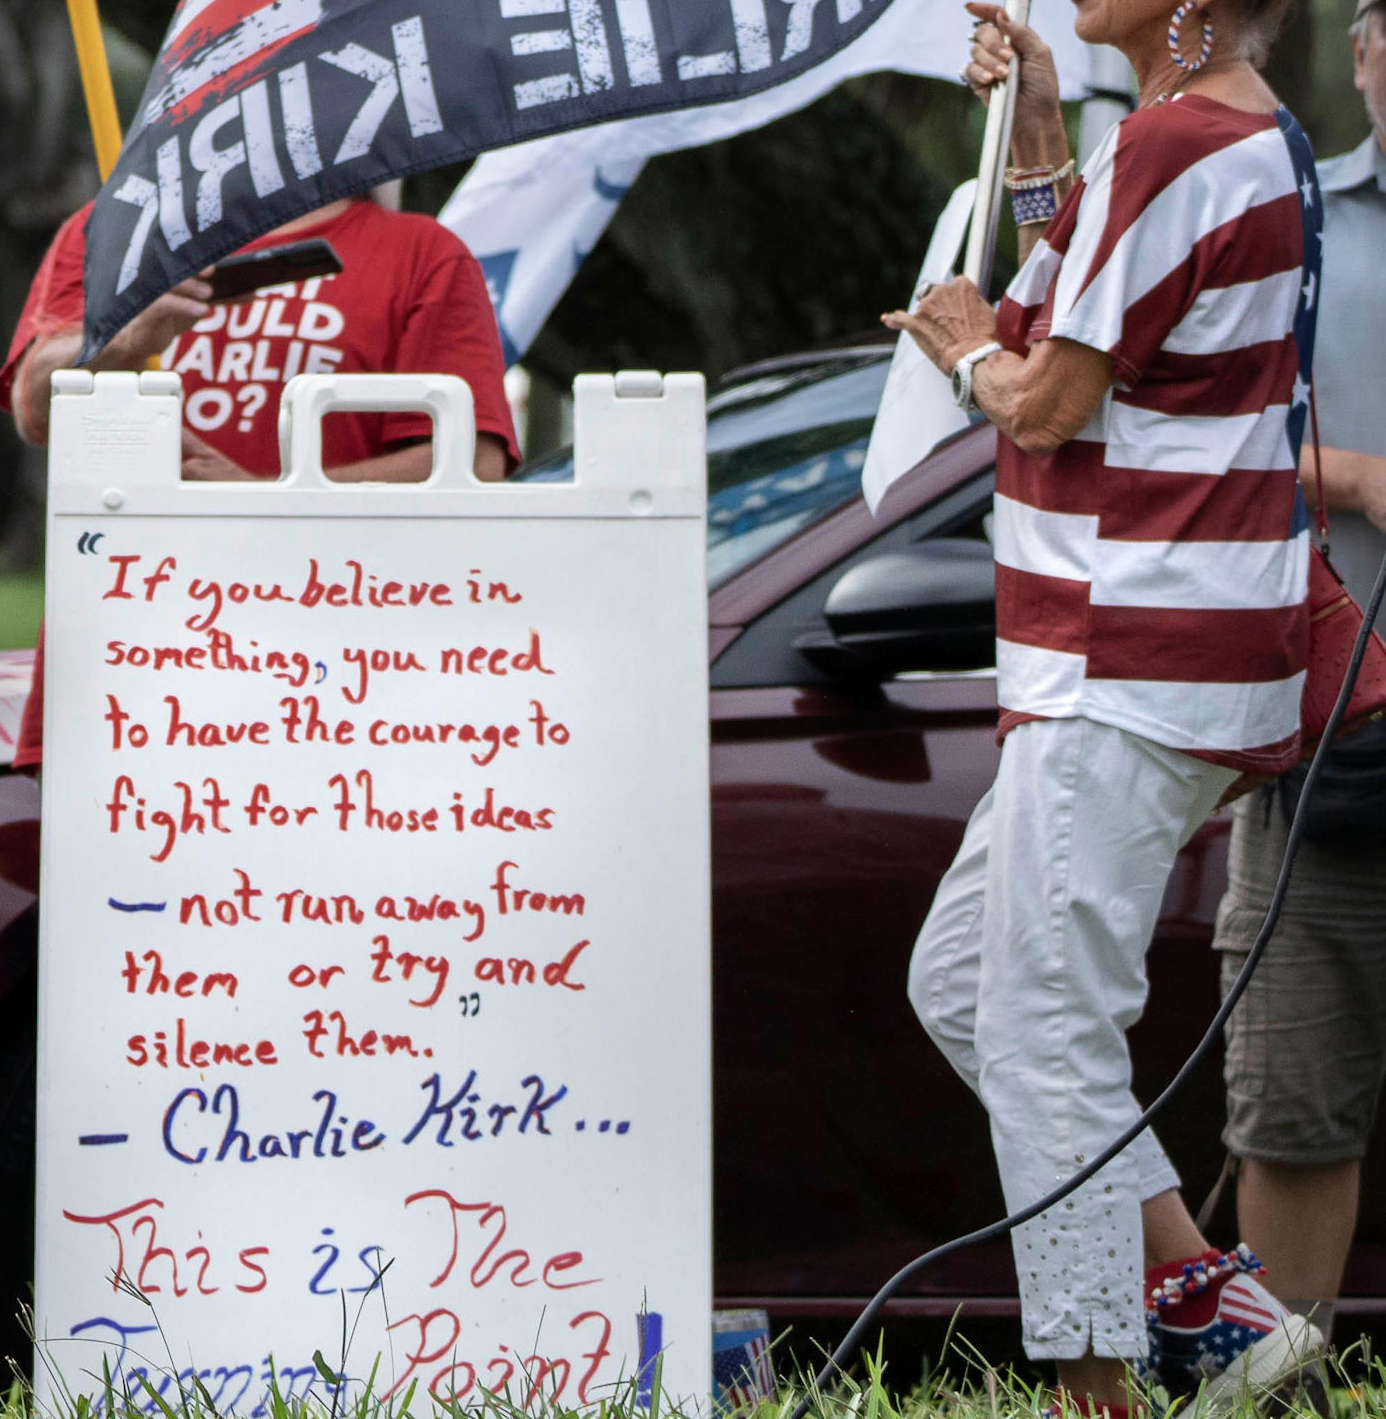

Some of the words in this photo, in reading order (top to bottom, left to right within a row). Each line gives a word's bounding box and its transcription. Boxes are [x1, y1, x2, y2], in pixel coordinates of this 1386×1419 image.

[185, 383, 267, 433] O?
[186, 580, 291, 632] you
[300, 560, 452, 607] believe
[468, 570, 522, 603] in
[106, 626, 327, 687] something,
[342, 649, 426, 703] you
[441, 633, 553, 675] need
[105, 695, 148, 749] to
[165, 696, 269, 746] have
[280, 695, 356, 744] the
[369, 720, 519, 765] courage
[530, 701, 569, 745] to
[107, 775, 230, 862] fight
[244, 784, 317, 826] for
[329, 770, 438, 832] those
[453, 788, 552, 832] ideas
[180, 869, 261, 926] not
[277, 890, 364, 925] run
[375, 895, 484, 942] away
[491, 861, 584, 915] from
[122, 950, 237, 997] them
[289, 964, 344, 987] or
[371, 935, 449, 1007] try
[475, 940, 589, 990] and
[128, 1019, 277, 1067] silence
[164, 1084, 386, 1165] Charlie
[63, 1197, 271, 1298] This
[308, 1228, 387, 1295] is
[405, 1188, 603, 1288] The
